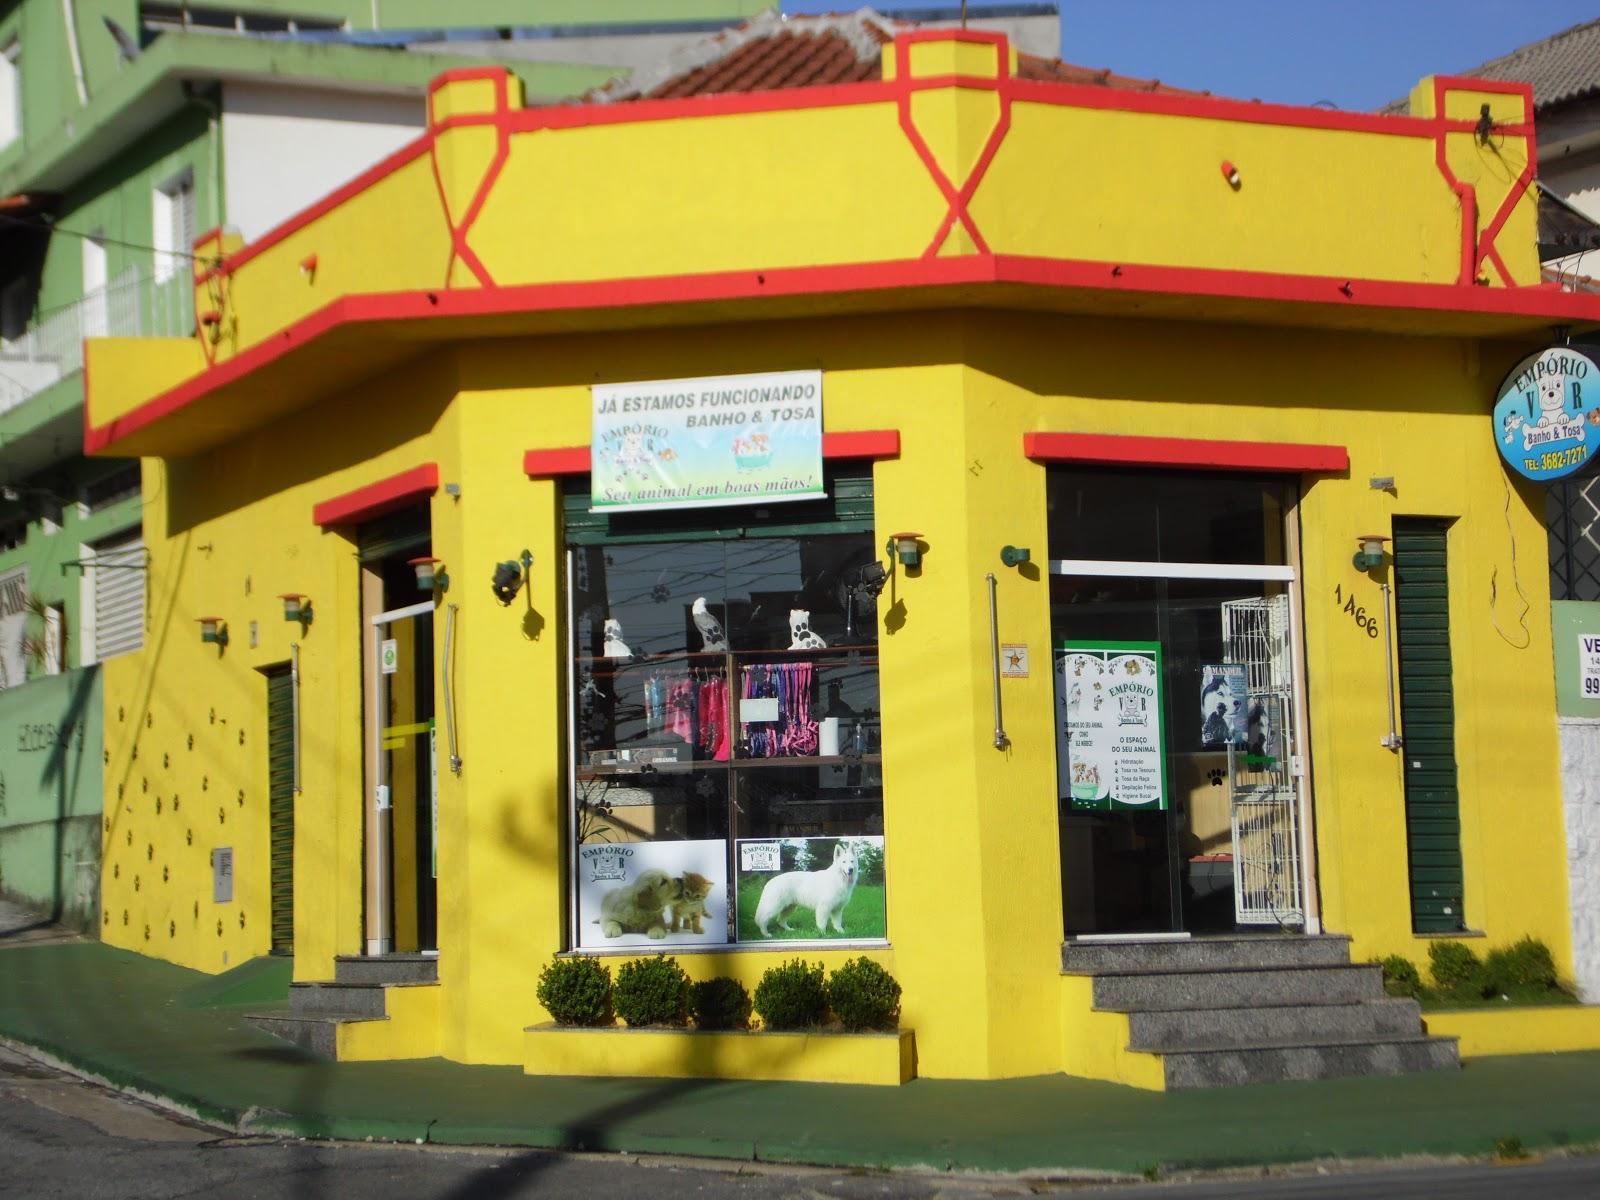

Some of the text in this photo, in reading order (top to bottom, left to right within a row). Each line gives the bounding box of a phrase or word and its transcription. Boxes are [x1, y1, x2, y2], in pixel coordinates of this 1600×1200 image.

[1514, 352, 1588, 393] EMPÓRIO
[598, 384, 815, 414] JÁ ESTAMOS FUNCIONANDO
[1526, 382, 1582, 419] V R
[686, 407, 815, 428] BANHO & TOSA
[601, 422, 668, 442] EMPÓRIO
[1527, 424, 1581, 445] Banho & Tosa
[602, 474, 812, 502] Seu animal em boas mãos!
[1335, 583, 1378, 639] 1466
[1109, 681, 1154, 697] EMPÓRIO
[1119, 697, 1147, 711] V R
[1126, 736, 1148, 745] ESPAÇO
[582, 845, 634, 859] EMPÓRIO
[593, 857, 625, 870] V R
